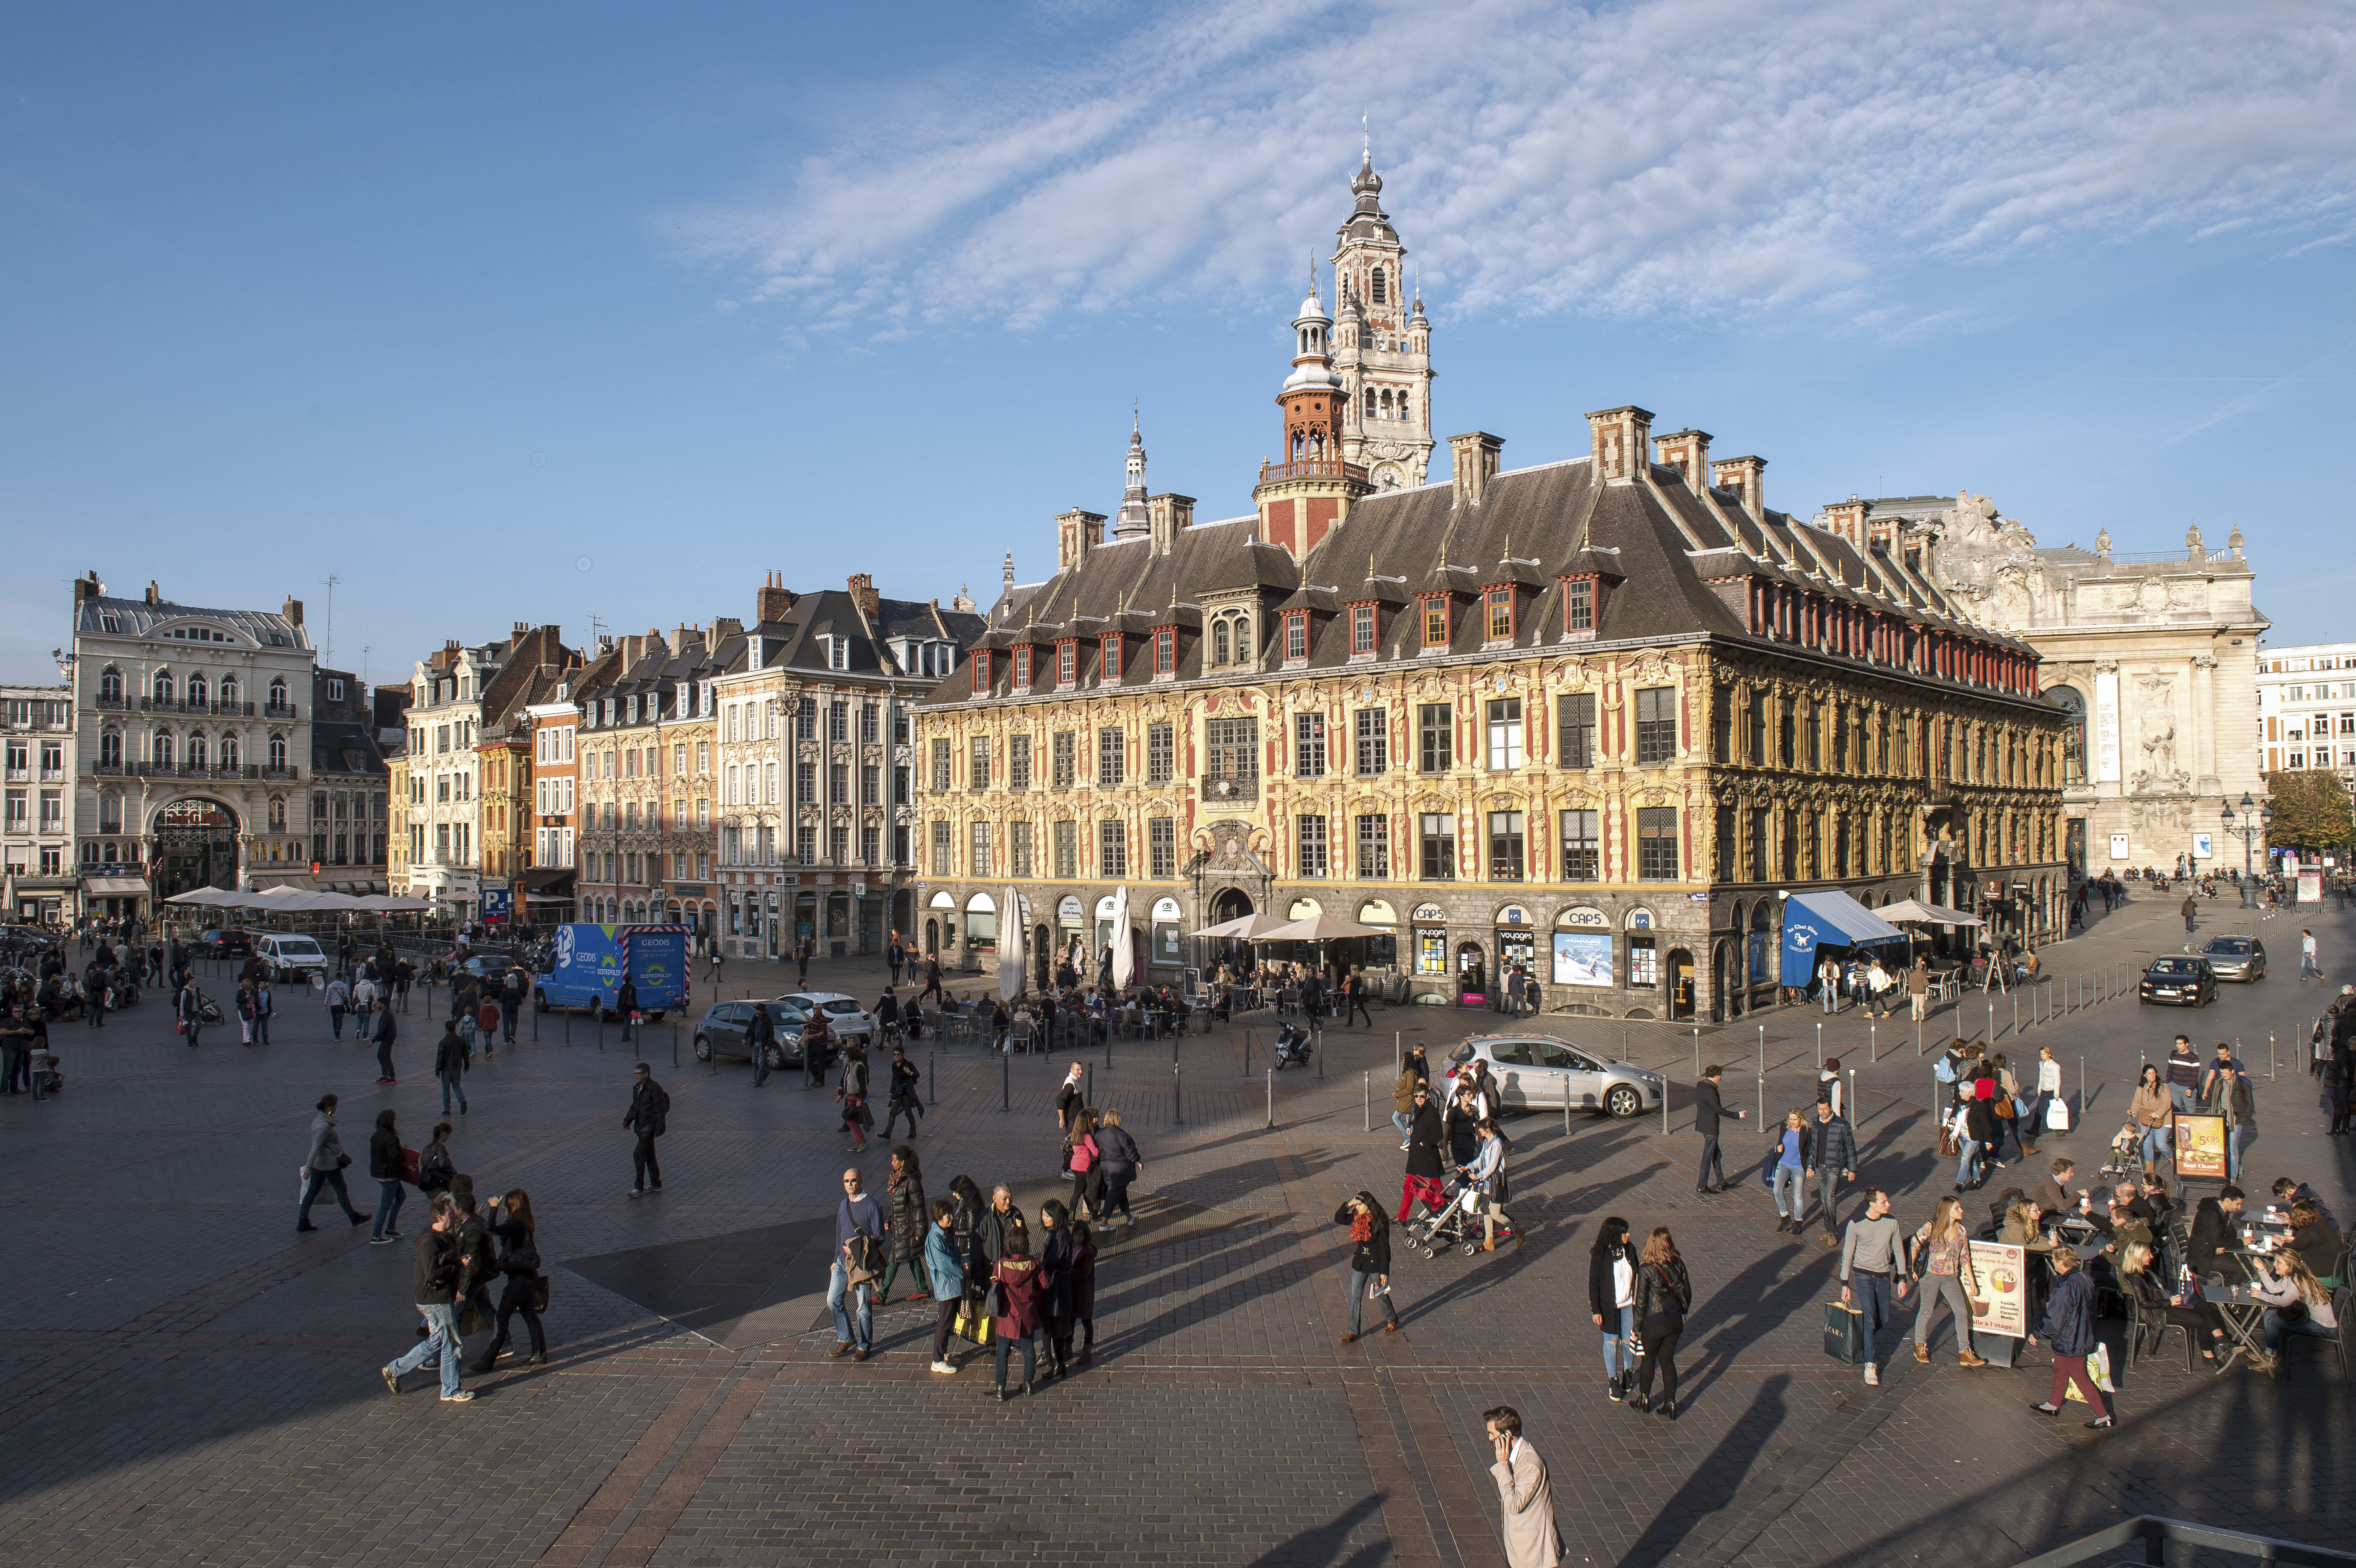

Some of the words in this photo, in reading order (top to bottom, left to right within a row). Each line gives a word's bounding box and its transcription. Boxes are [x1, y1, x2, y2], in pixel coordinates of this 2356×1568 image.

[168, 811, 224, 824] ALCIDE
[486, 892, 499, 909] P
[1417, 929, 1446, 937] voyages
[1807, 925, 1819, 936] Bleu
[1500, 932, 1532, 941] voyages
[576, 952, 596, 962] GEODIS
[1990, 1322, 2012, 1330] l'étage
[1828, 1326, 1843, 1339] ZARA
